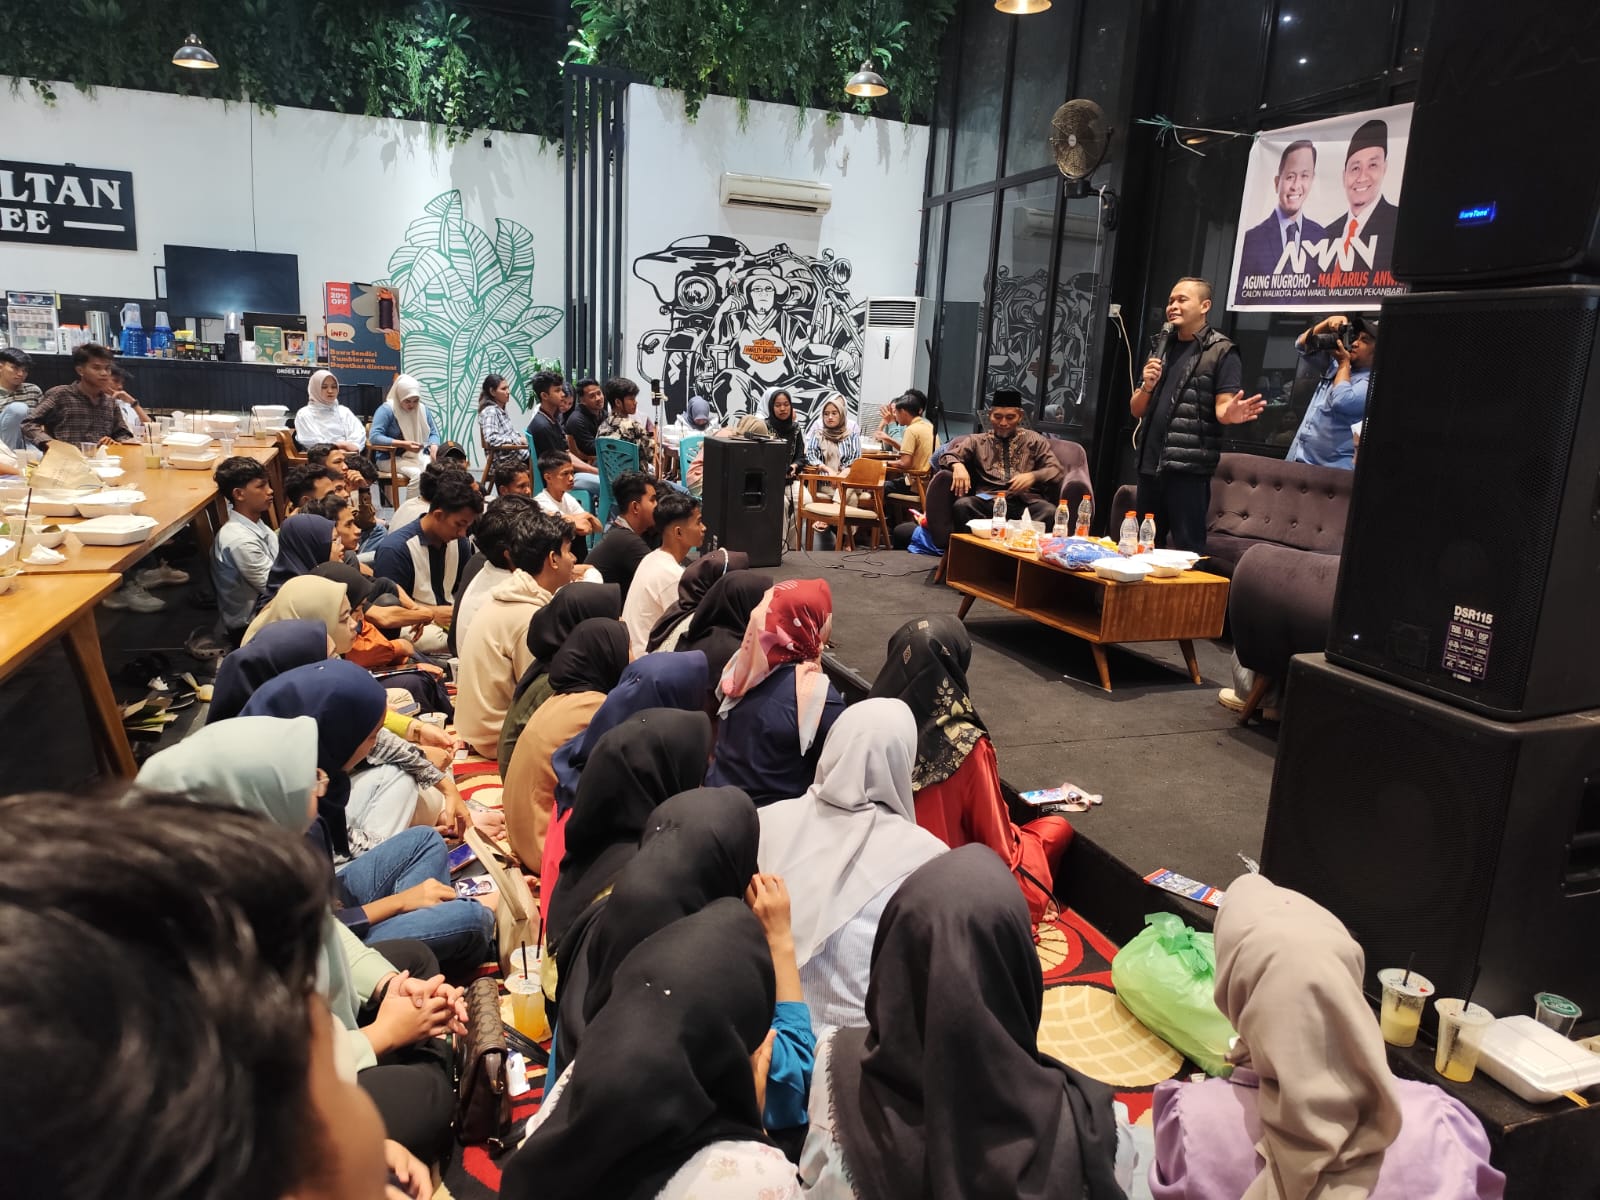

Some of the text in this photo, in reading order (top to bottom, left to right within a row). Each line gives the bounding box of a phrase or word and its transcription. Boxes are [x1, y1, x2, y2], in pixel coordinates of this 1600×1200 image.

[0, 170, 122, 210] LTAN
[1273, 235, 1378, 274] AMAN
[1243, 275, 1270, 290] AGUNG
[1271, 273, 1311, 289] NUGROHO
[1318, 271, 1369, 288] MARKARIUS
[1372, 271, 1405, 287] ANW
[1241, 290, 1261, 298] CALON
[1262, 289, 1291, 297] WALIKOTA
[1292, 289, 1307, 297] DAN
[1307, 288, 1327, 297] WAKIL
[1328, 288, 1362, 297] WALIKOTA
[1454, 605, 1494, 625] DSR115
